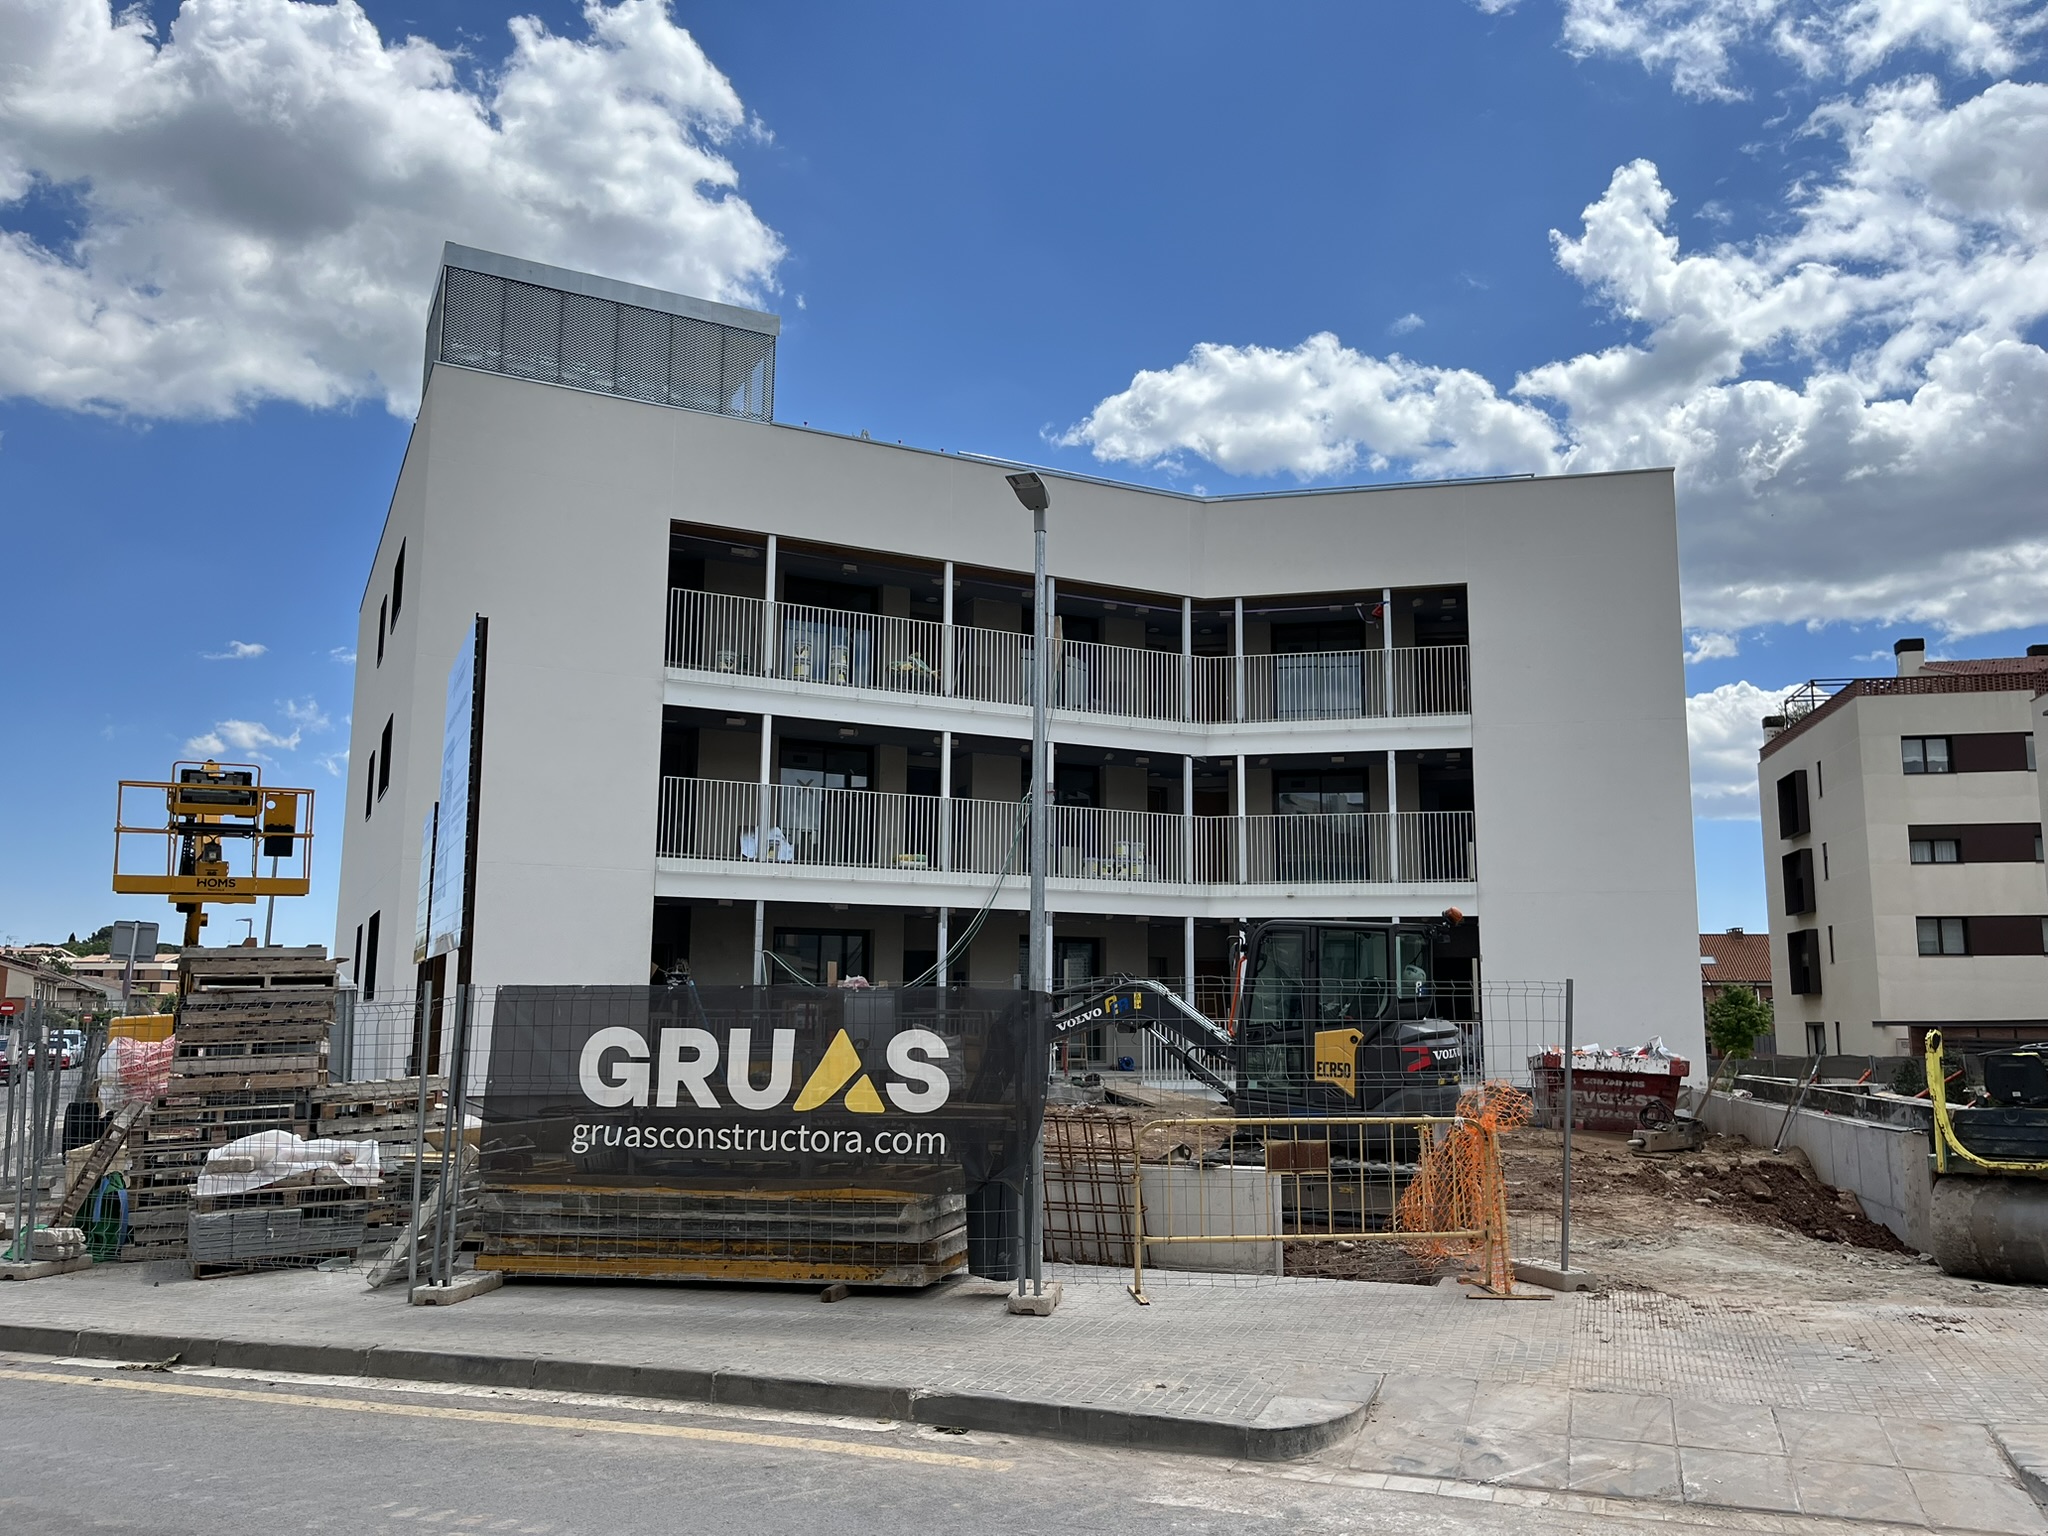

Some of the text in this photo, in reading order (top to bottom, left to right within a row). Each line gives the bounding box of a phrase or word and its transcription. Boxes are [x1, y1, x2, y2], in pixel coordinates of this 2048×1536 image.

[196, 878, 236, 888] HOMS
[1056, 1007, 1102, 1031] VOLVO
[578, 1026, 951, 1114] GRUAS
[1316, 1061, 1351, 1079] ECR50
[570, 1121, 946, 1155] gruasconstructora.com
